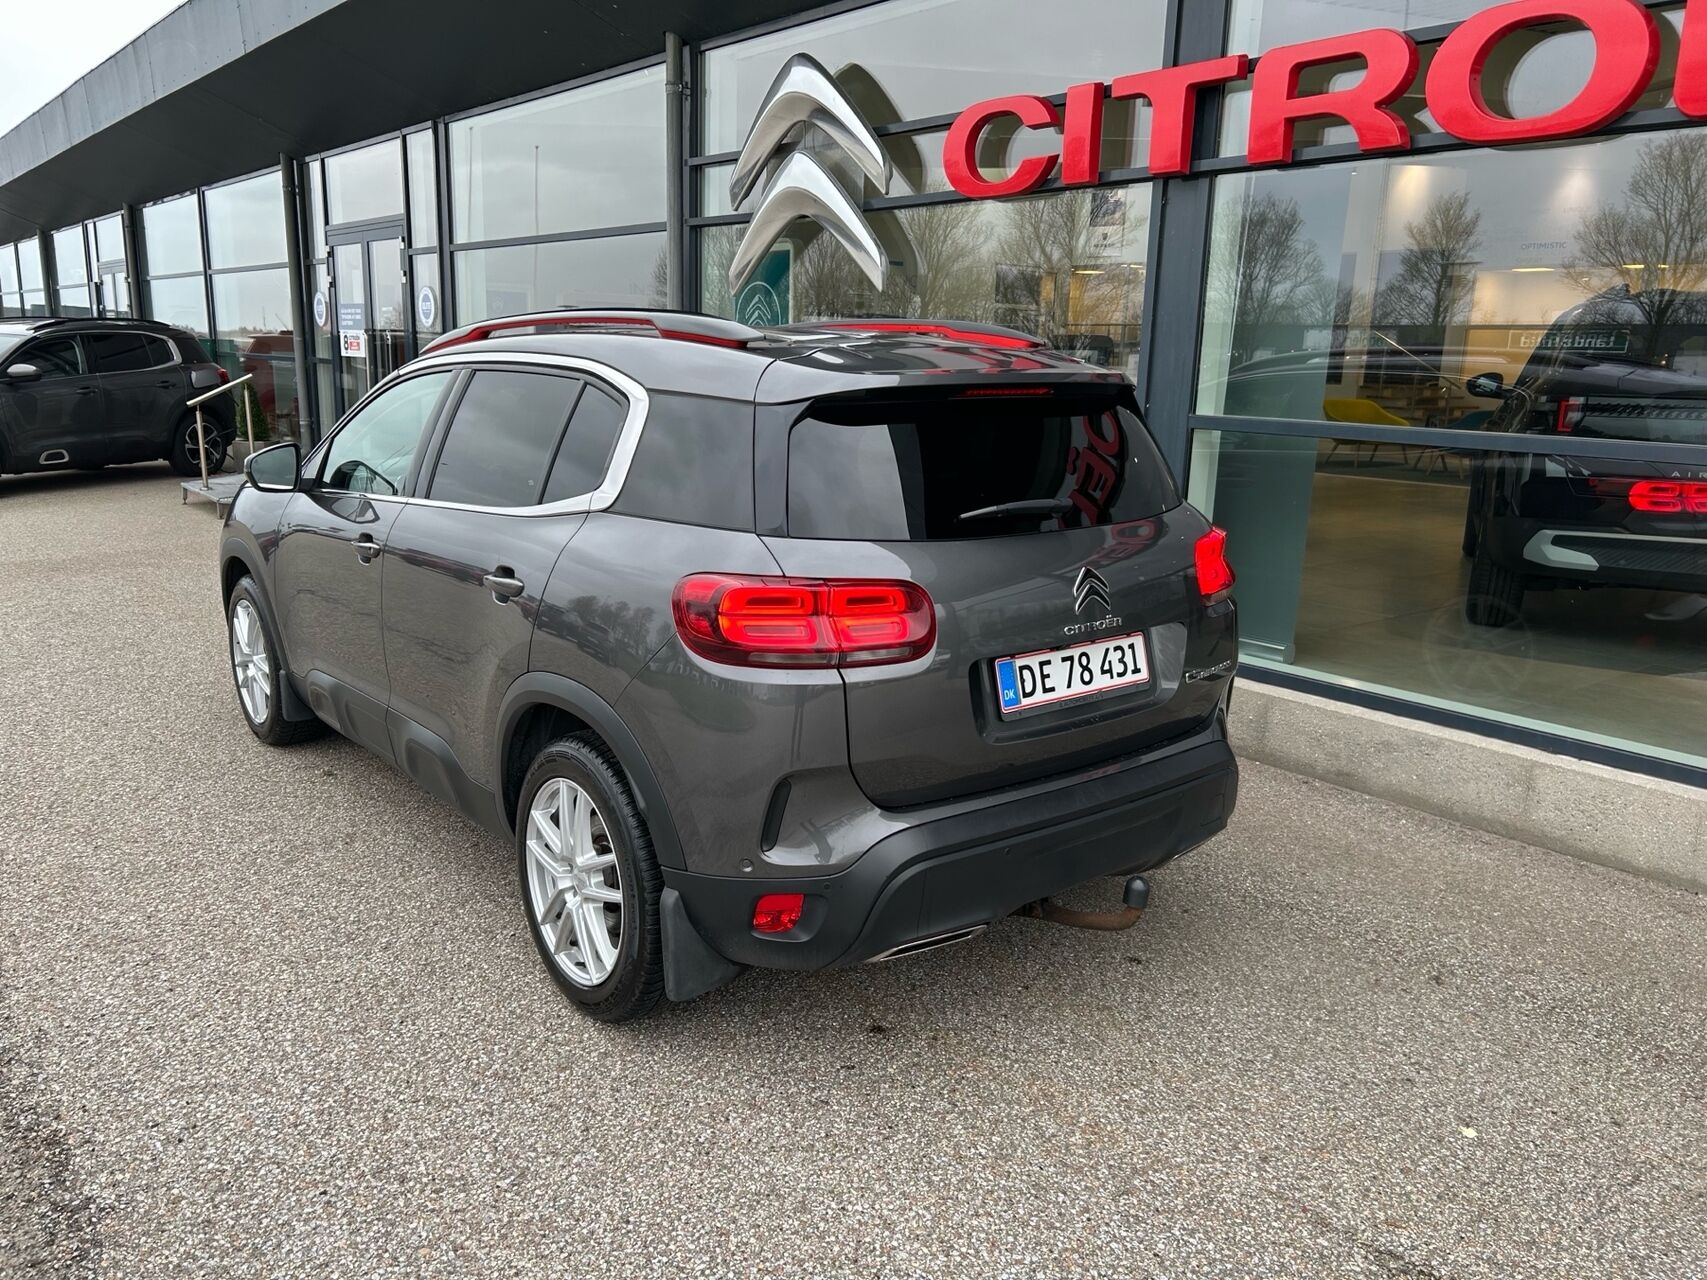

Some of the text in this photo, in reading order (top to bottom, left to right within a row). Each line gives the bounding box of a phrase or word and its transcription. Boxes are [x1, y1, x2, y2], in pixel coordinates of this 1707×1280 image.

[943, 0, 1707, 199] CITRO
[1520, 241, 1567, 250] OPTIMISTIC
[1018, 659, 1056, 699] DE
[1060, 651, 1094, 687] 78
[1100, 642, 1142, 680] 431
[1004, 689, 1016, 700] DK
